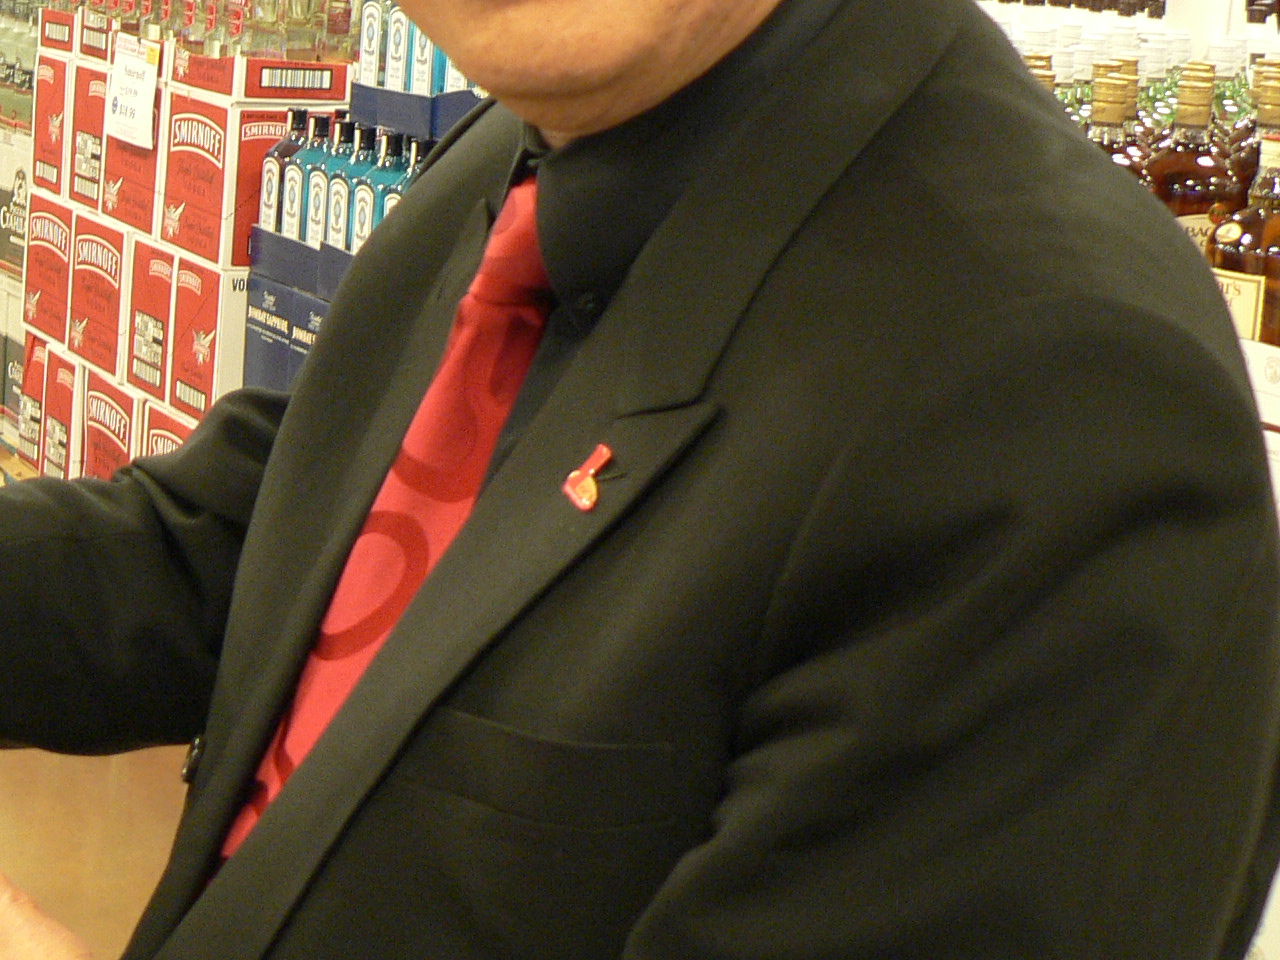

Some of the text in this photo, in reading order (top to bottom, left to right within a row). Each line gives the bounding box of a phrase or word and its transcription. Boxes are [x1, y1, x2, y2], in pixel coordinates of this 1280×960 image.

[173, 120, 221, 158] SMIRNOFF
[31, 217, 67, 251] SMIRNOFF
[77, 240, 118, 277] SMIRNOFF
[232, 278, 248, 292] VO
[88, 396, 127, 440] SMIRNOFF
